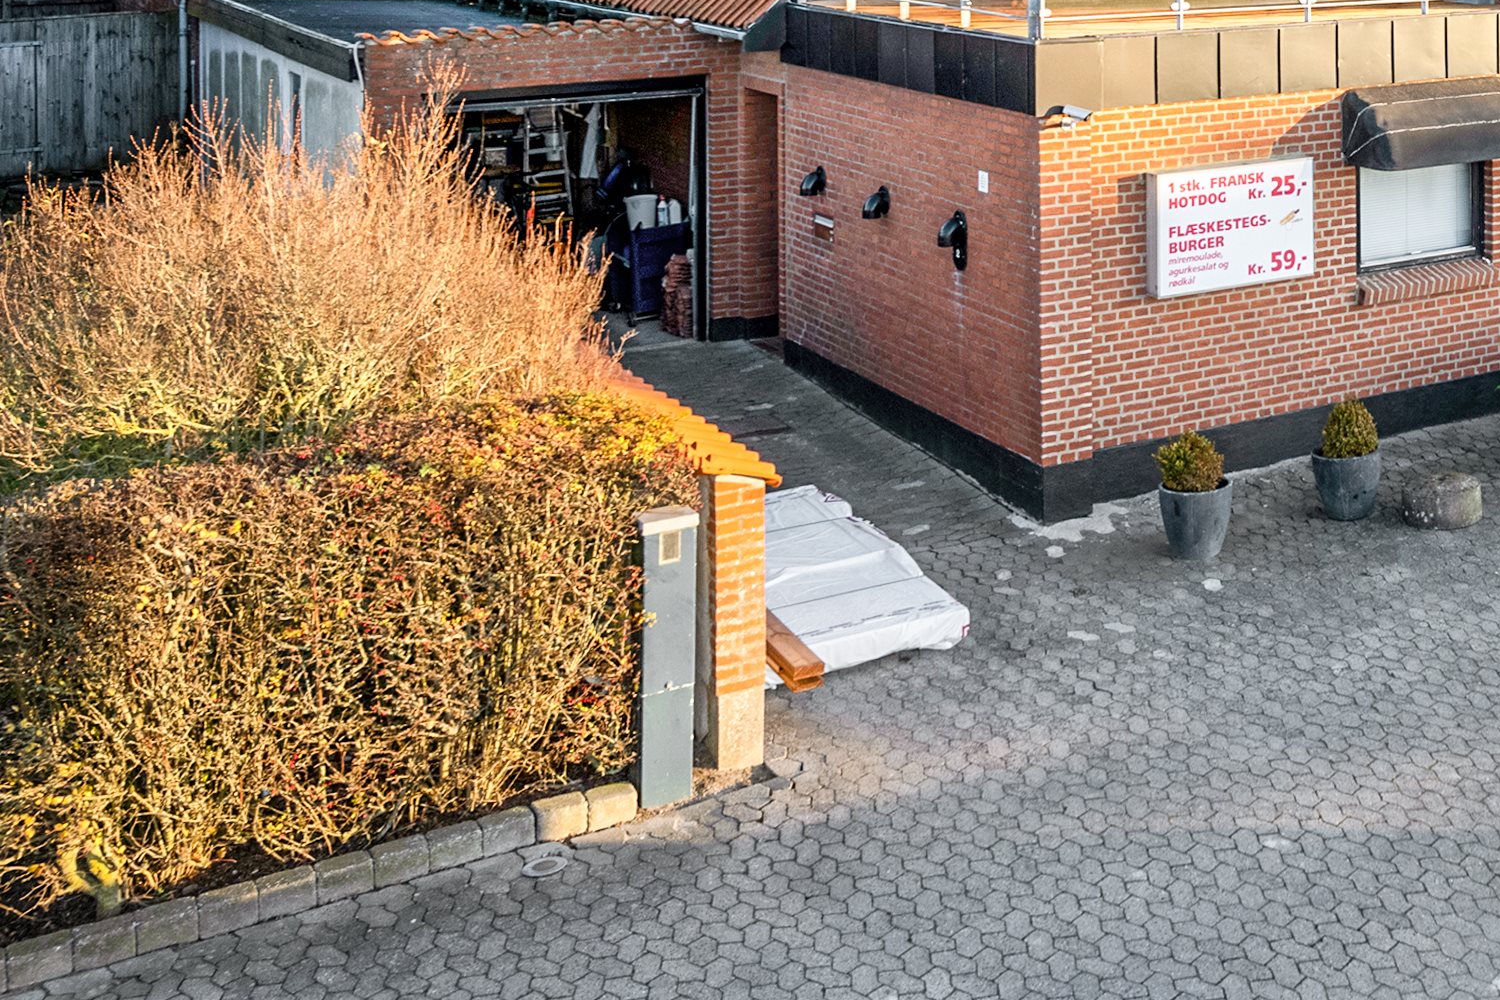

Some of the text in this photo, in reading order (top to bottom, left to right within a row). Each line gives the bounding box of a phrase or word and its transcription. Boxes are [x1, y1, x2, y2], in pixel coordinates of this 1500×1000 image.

[1168, 171, 1265, 194] 1 stk. FRANSK
[1247, 174, 1307, 200] Kr. 25,-
[1168, 191, 1227, 210] HOTDOG
[1168, 235, 1225, 254] BURGER
[1247, 249, 1307, 276] Kr. 59,-
